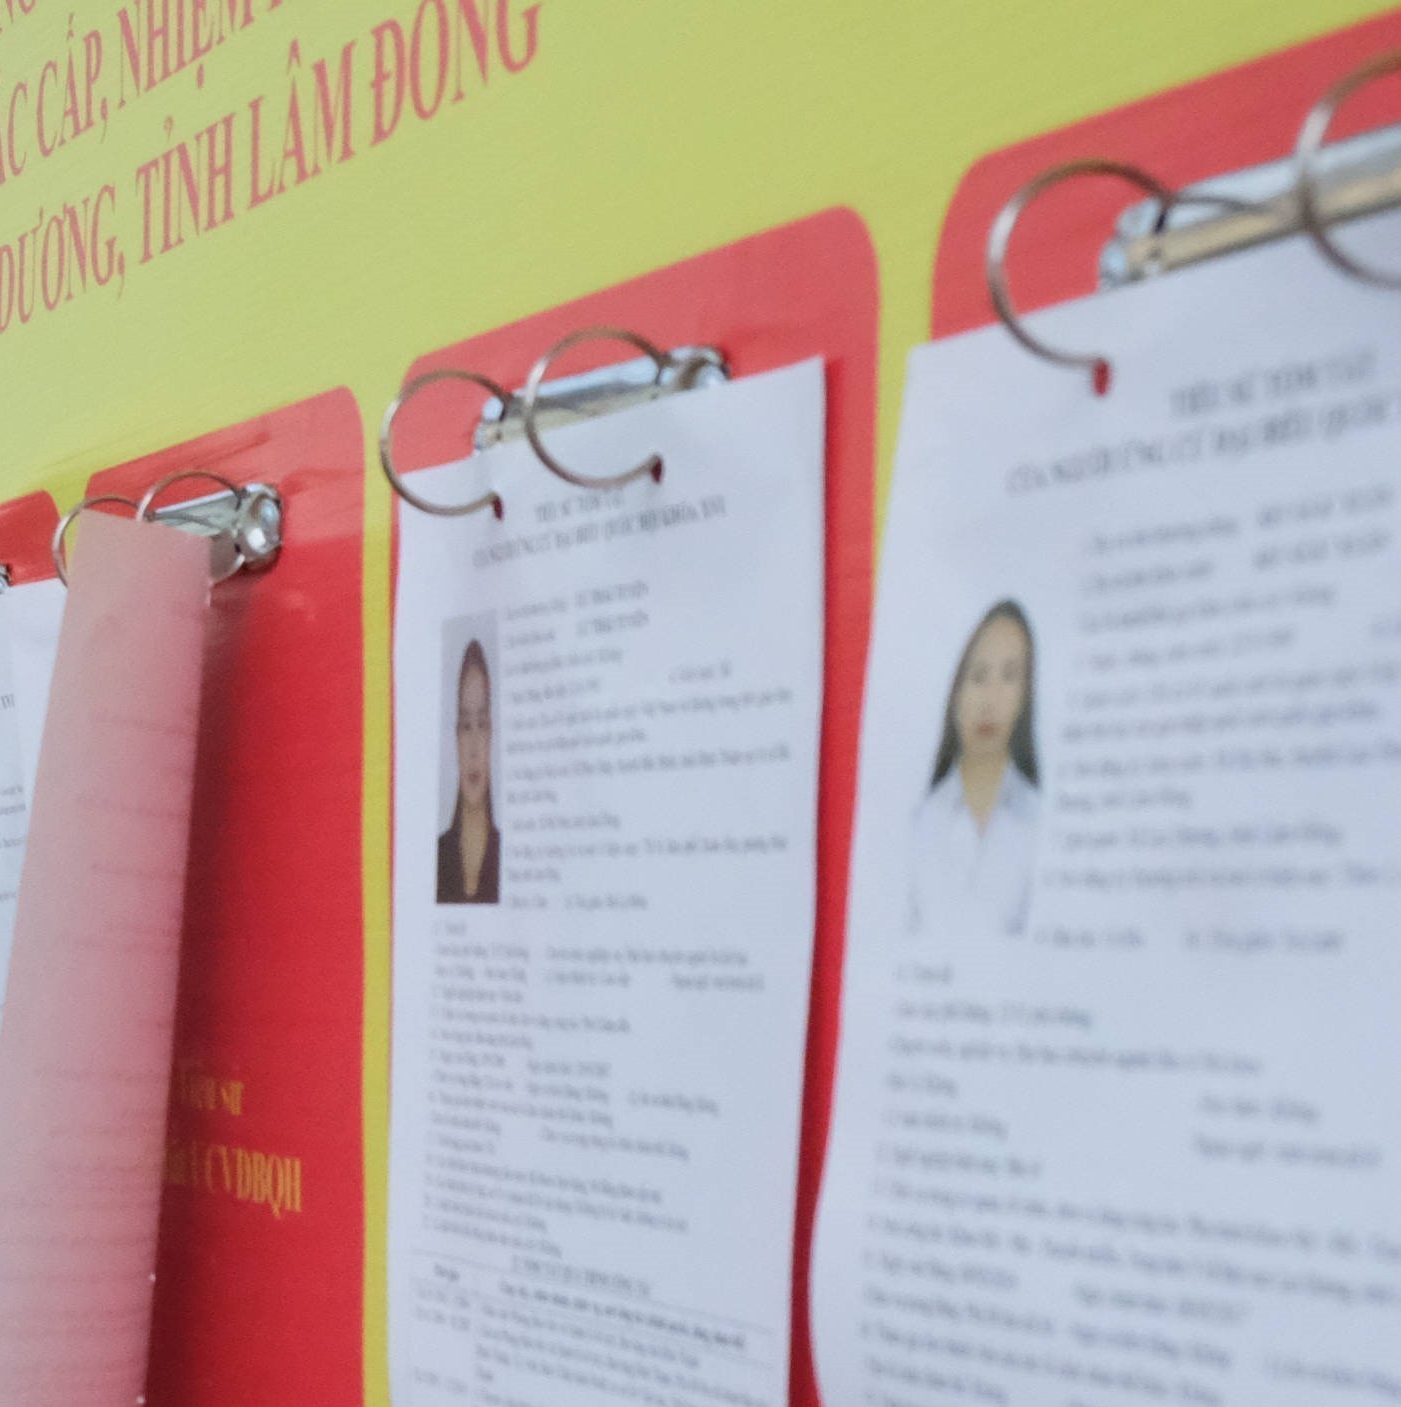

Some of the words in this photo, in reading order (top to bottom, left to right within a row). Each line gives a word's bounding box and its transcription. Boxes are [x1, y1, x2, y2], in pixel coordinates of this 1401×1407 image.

[36, 12, 108, 158] CẤP,
[134, 112, 236, 265] TỈNH
[246, 39, 357, 211] LÂM
